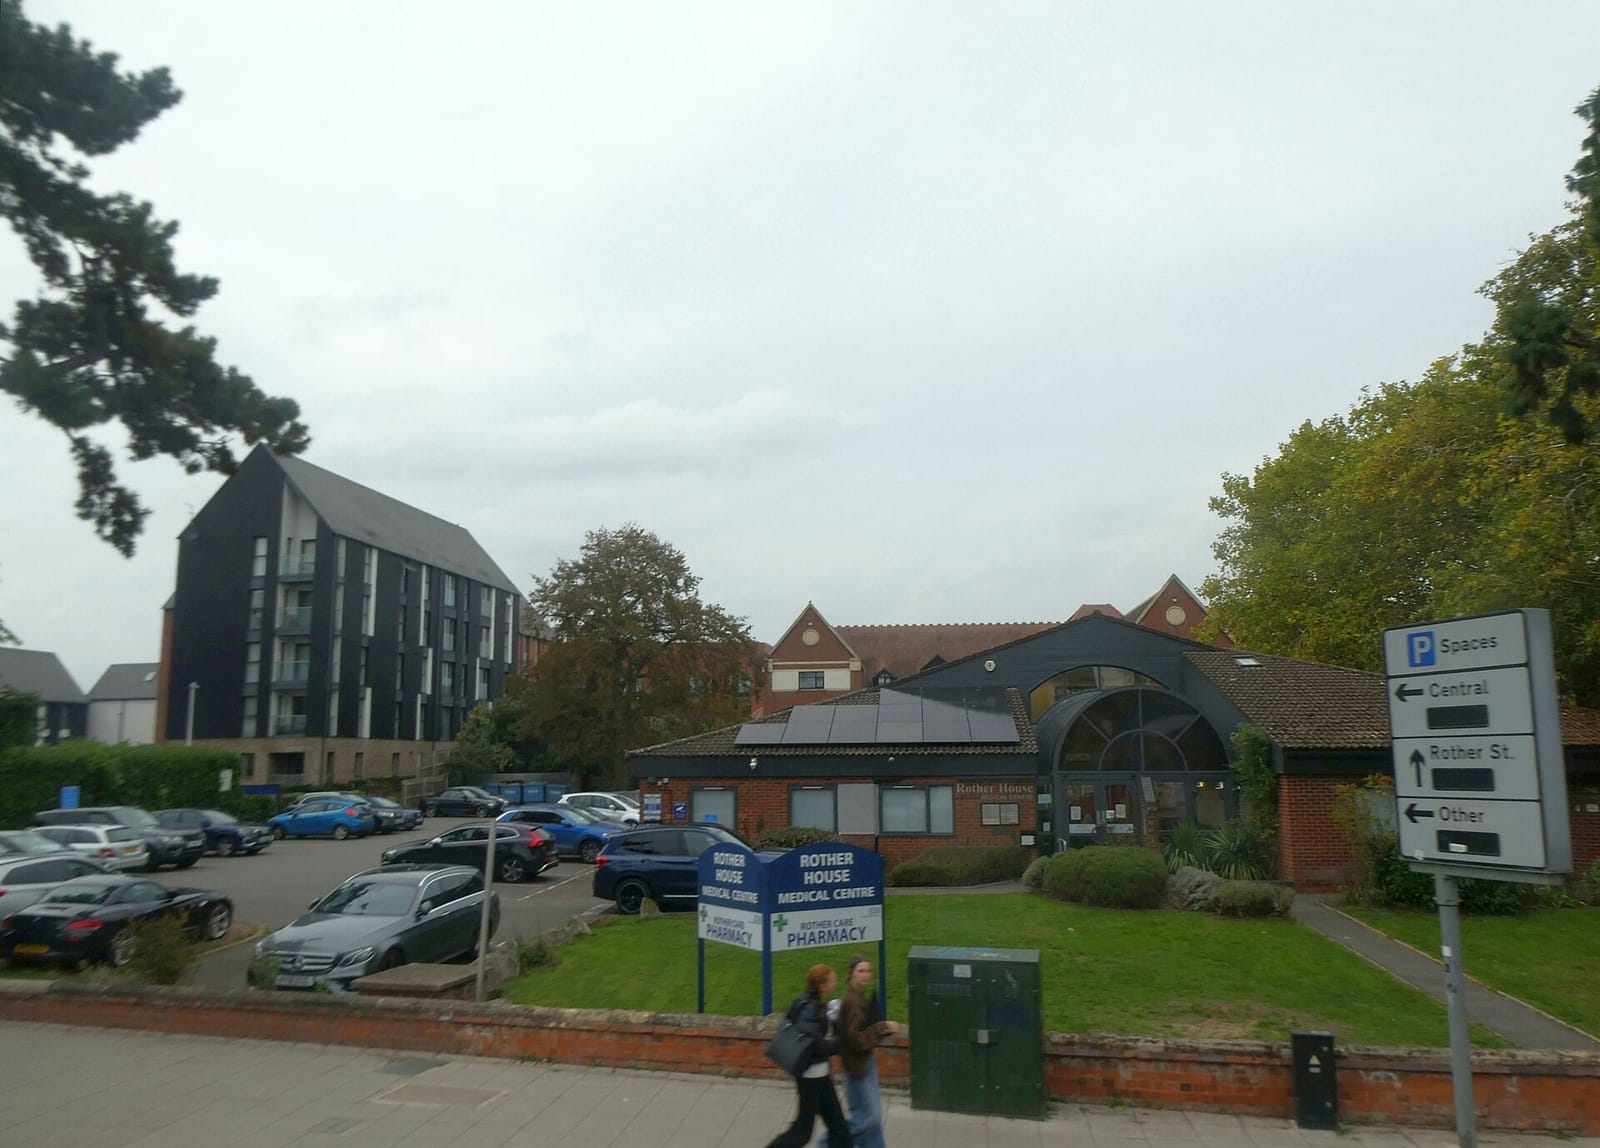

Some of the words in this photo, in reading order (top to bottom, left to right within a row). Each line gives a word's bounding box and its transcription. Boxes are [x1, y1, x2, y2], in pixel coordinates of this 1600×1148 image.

[1440, 636, 1498, 655] Spaces
[1429, 679, 1489, 698] Central
[1430, 745, 1483, 760] Rother
[1490, 744, 1515, 760] St.
[956, 783, 994, 793] Rother
[999, 783, 1034, 793] House
[1439, 806, 1484, 823] Other
[714, 852, 745, 867] ROTHER
[800, 852, 854, 868] ROTHER
[716, 869, 743, 884] HOUSE
[803, 869, 850, 885] HOUSE
[702, 886, 731, 899] MEDICAL
[731, 890, 759, 904] CENTRE
[778, 890, 829, 904] MEDICAL
[833, 887, 875, 900] CENTRE
[800, 920, 831, 930] ROTHER
[833, 918, 853, 927] CARE
[706, 924, 752, 945] PHARMACY
[788, 927, 866, 947] PHARMACY
